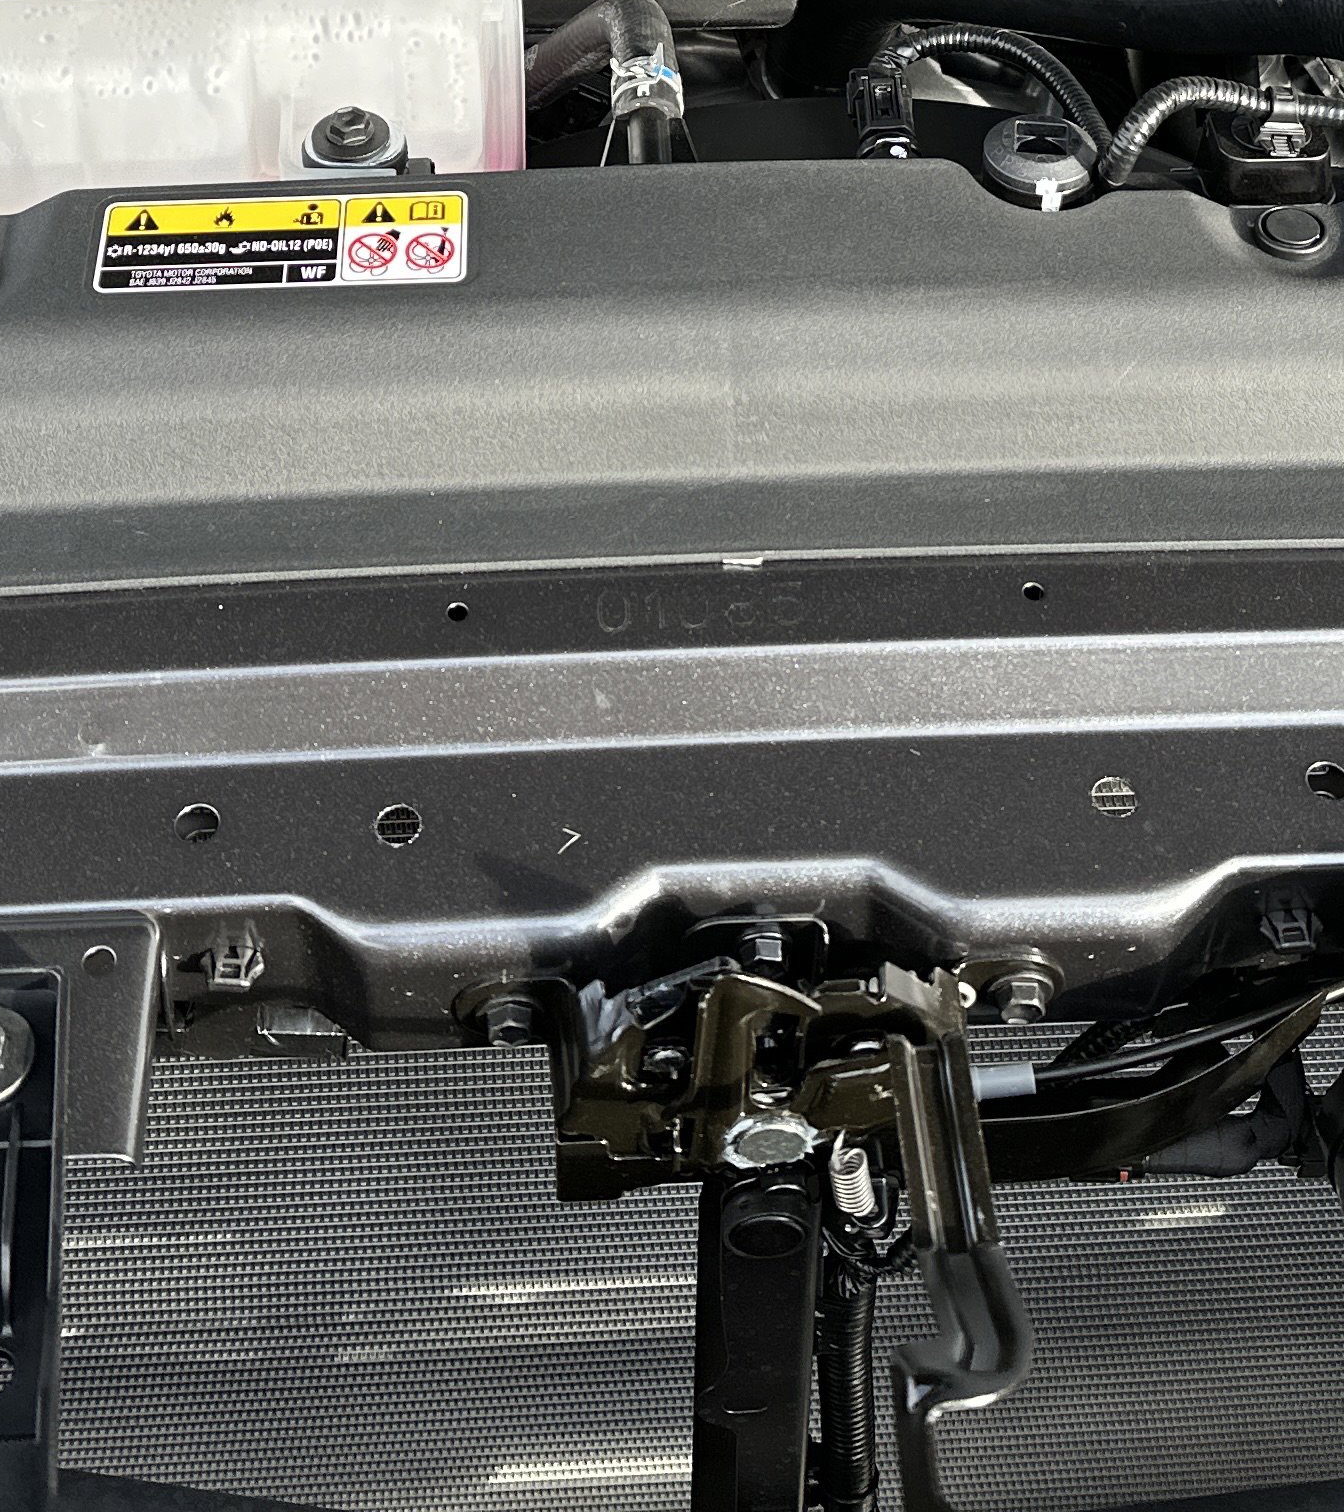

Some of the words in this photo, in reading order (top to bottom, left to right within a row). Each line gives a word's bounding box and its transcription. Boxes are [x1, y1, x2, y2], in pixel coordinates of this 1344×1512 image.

[123, 244, 175, 256] R-1234yf
[303, 238, 333, 252] (POE)
[130, 270, 163, 278] TOYOTA
[164, 269, 194, 277] MOTOR
[195, 267, 253, 276] CORPORATION
[300, 265, 327, 280] WF
